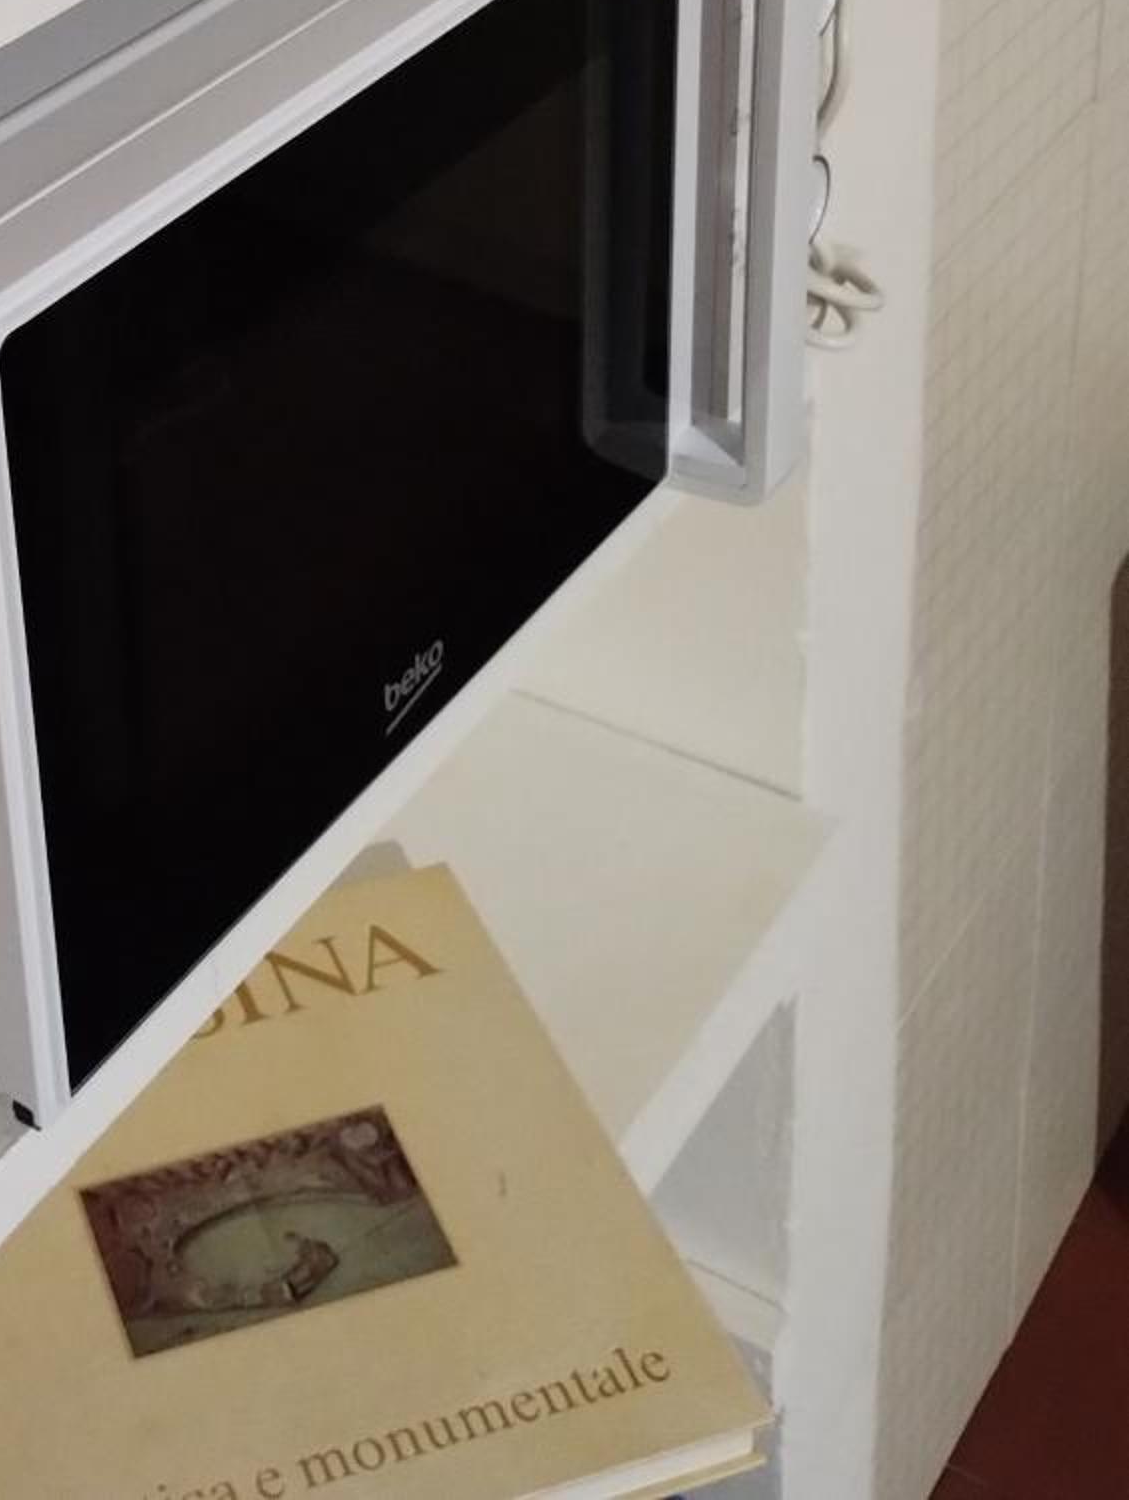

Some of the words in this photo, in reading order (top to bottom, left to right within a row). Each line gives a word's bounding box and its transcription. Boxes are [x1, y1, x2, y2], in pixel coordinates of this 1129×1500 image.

[383, 638, 444, 713] beko
[255, 1465, 284, 1498] e
[298, 1346, 671, 1488] monumentale
